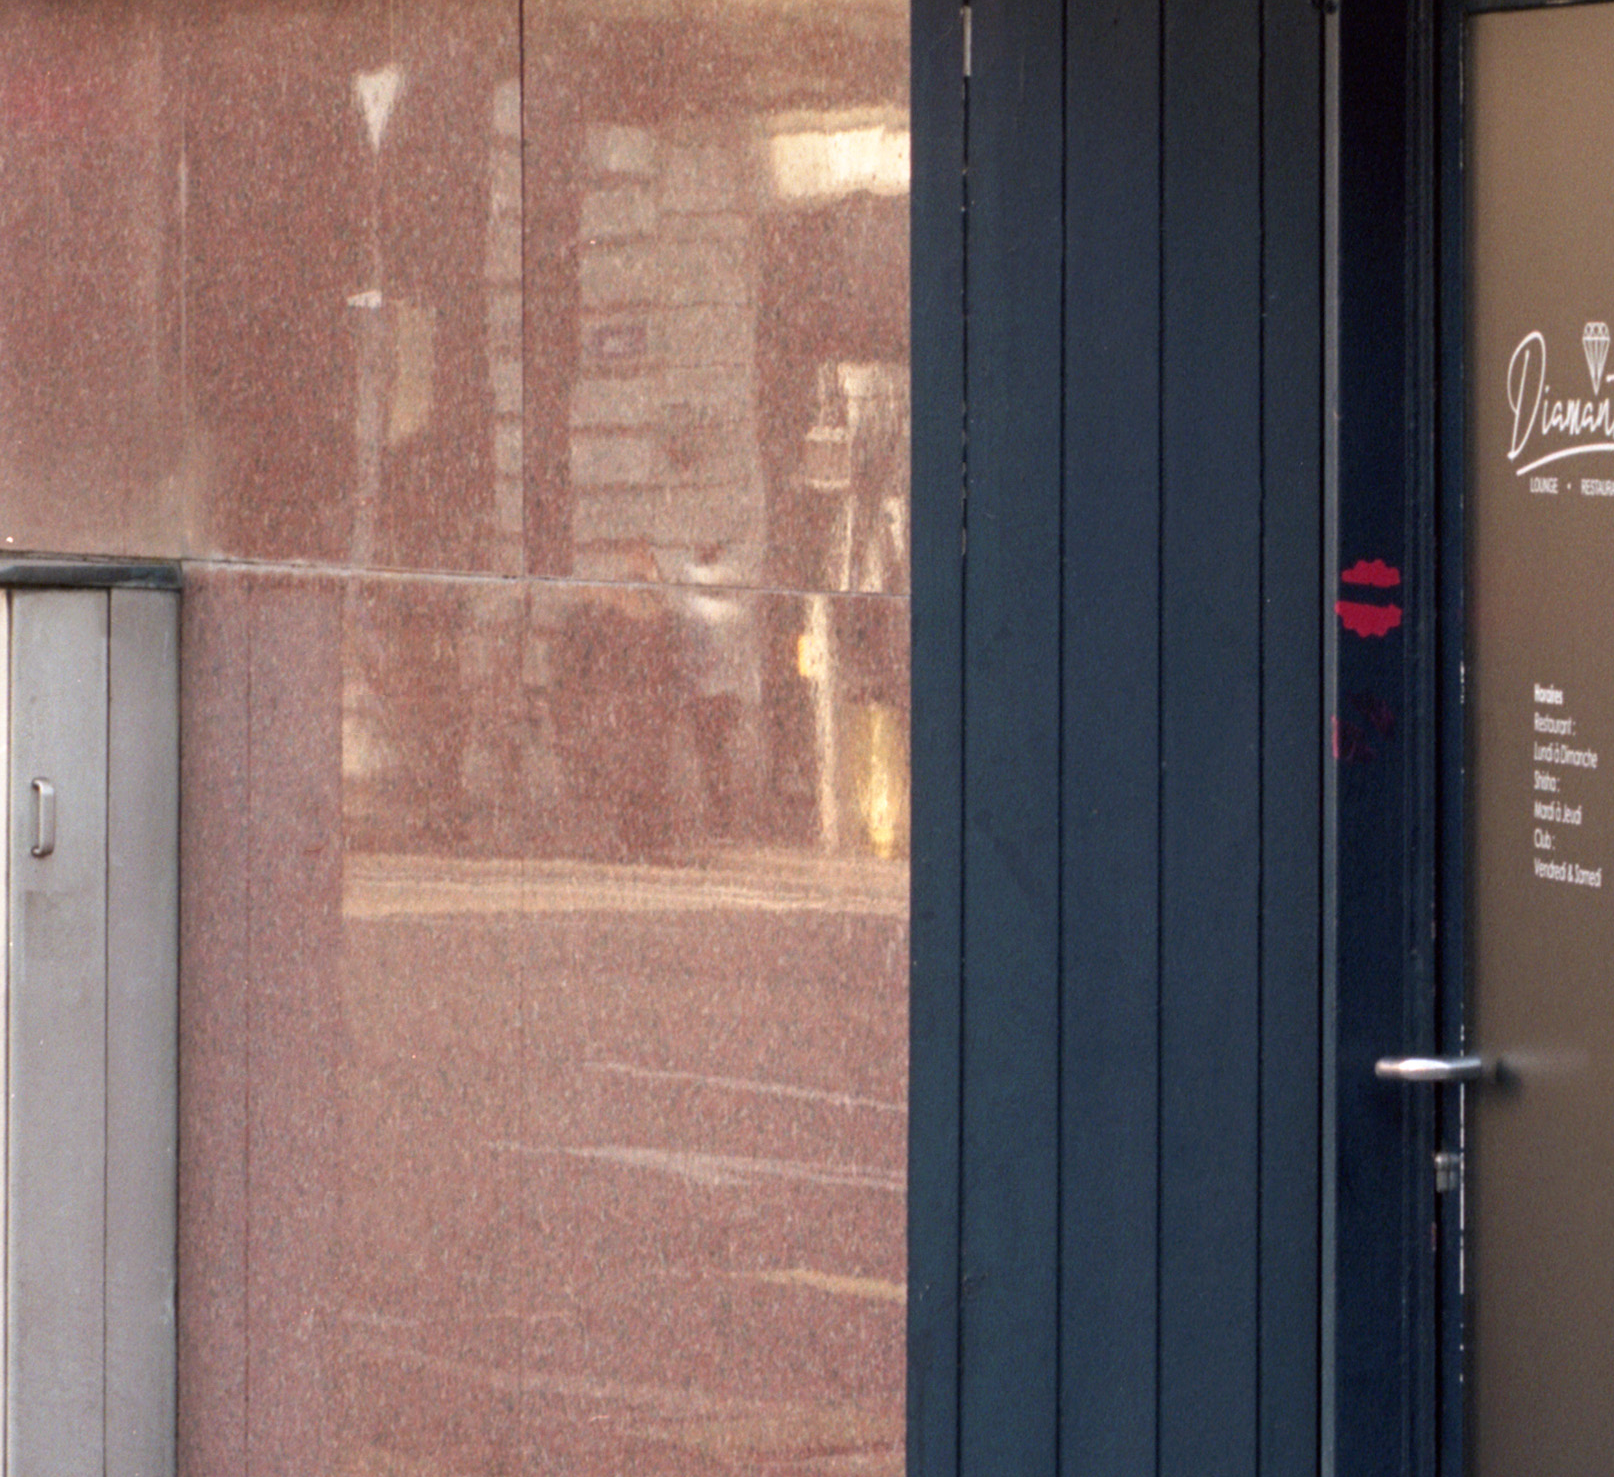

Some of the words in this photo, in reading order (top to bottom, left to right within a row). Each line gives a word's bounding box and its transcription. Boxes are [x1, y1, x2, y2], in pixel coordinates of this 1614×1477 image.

[1530, 477, 1559, 495] LOUNGE
[1534, 683, 1563, 705] Horaires
[1534, 742, 1553, 762] Lundi
[1560, 744, 1598, 769] Dimanche
[1534, 800, 1554, 821] Mardi
[1562, 804, 1582, 825] Jeudi
[1534, 858, 1566, 882] Vendredi
[1567, 864, 1573, 883] &
[1574, 864, 1602, 888] Samedi
